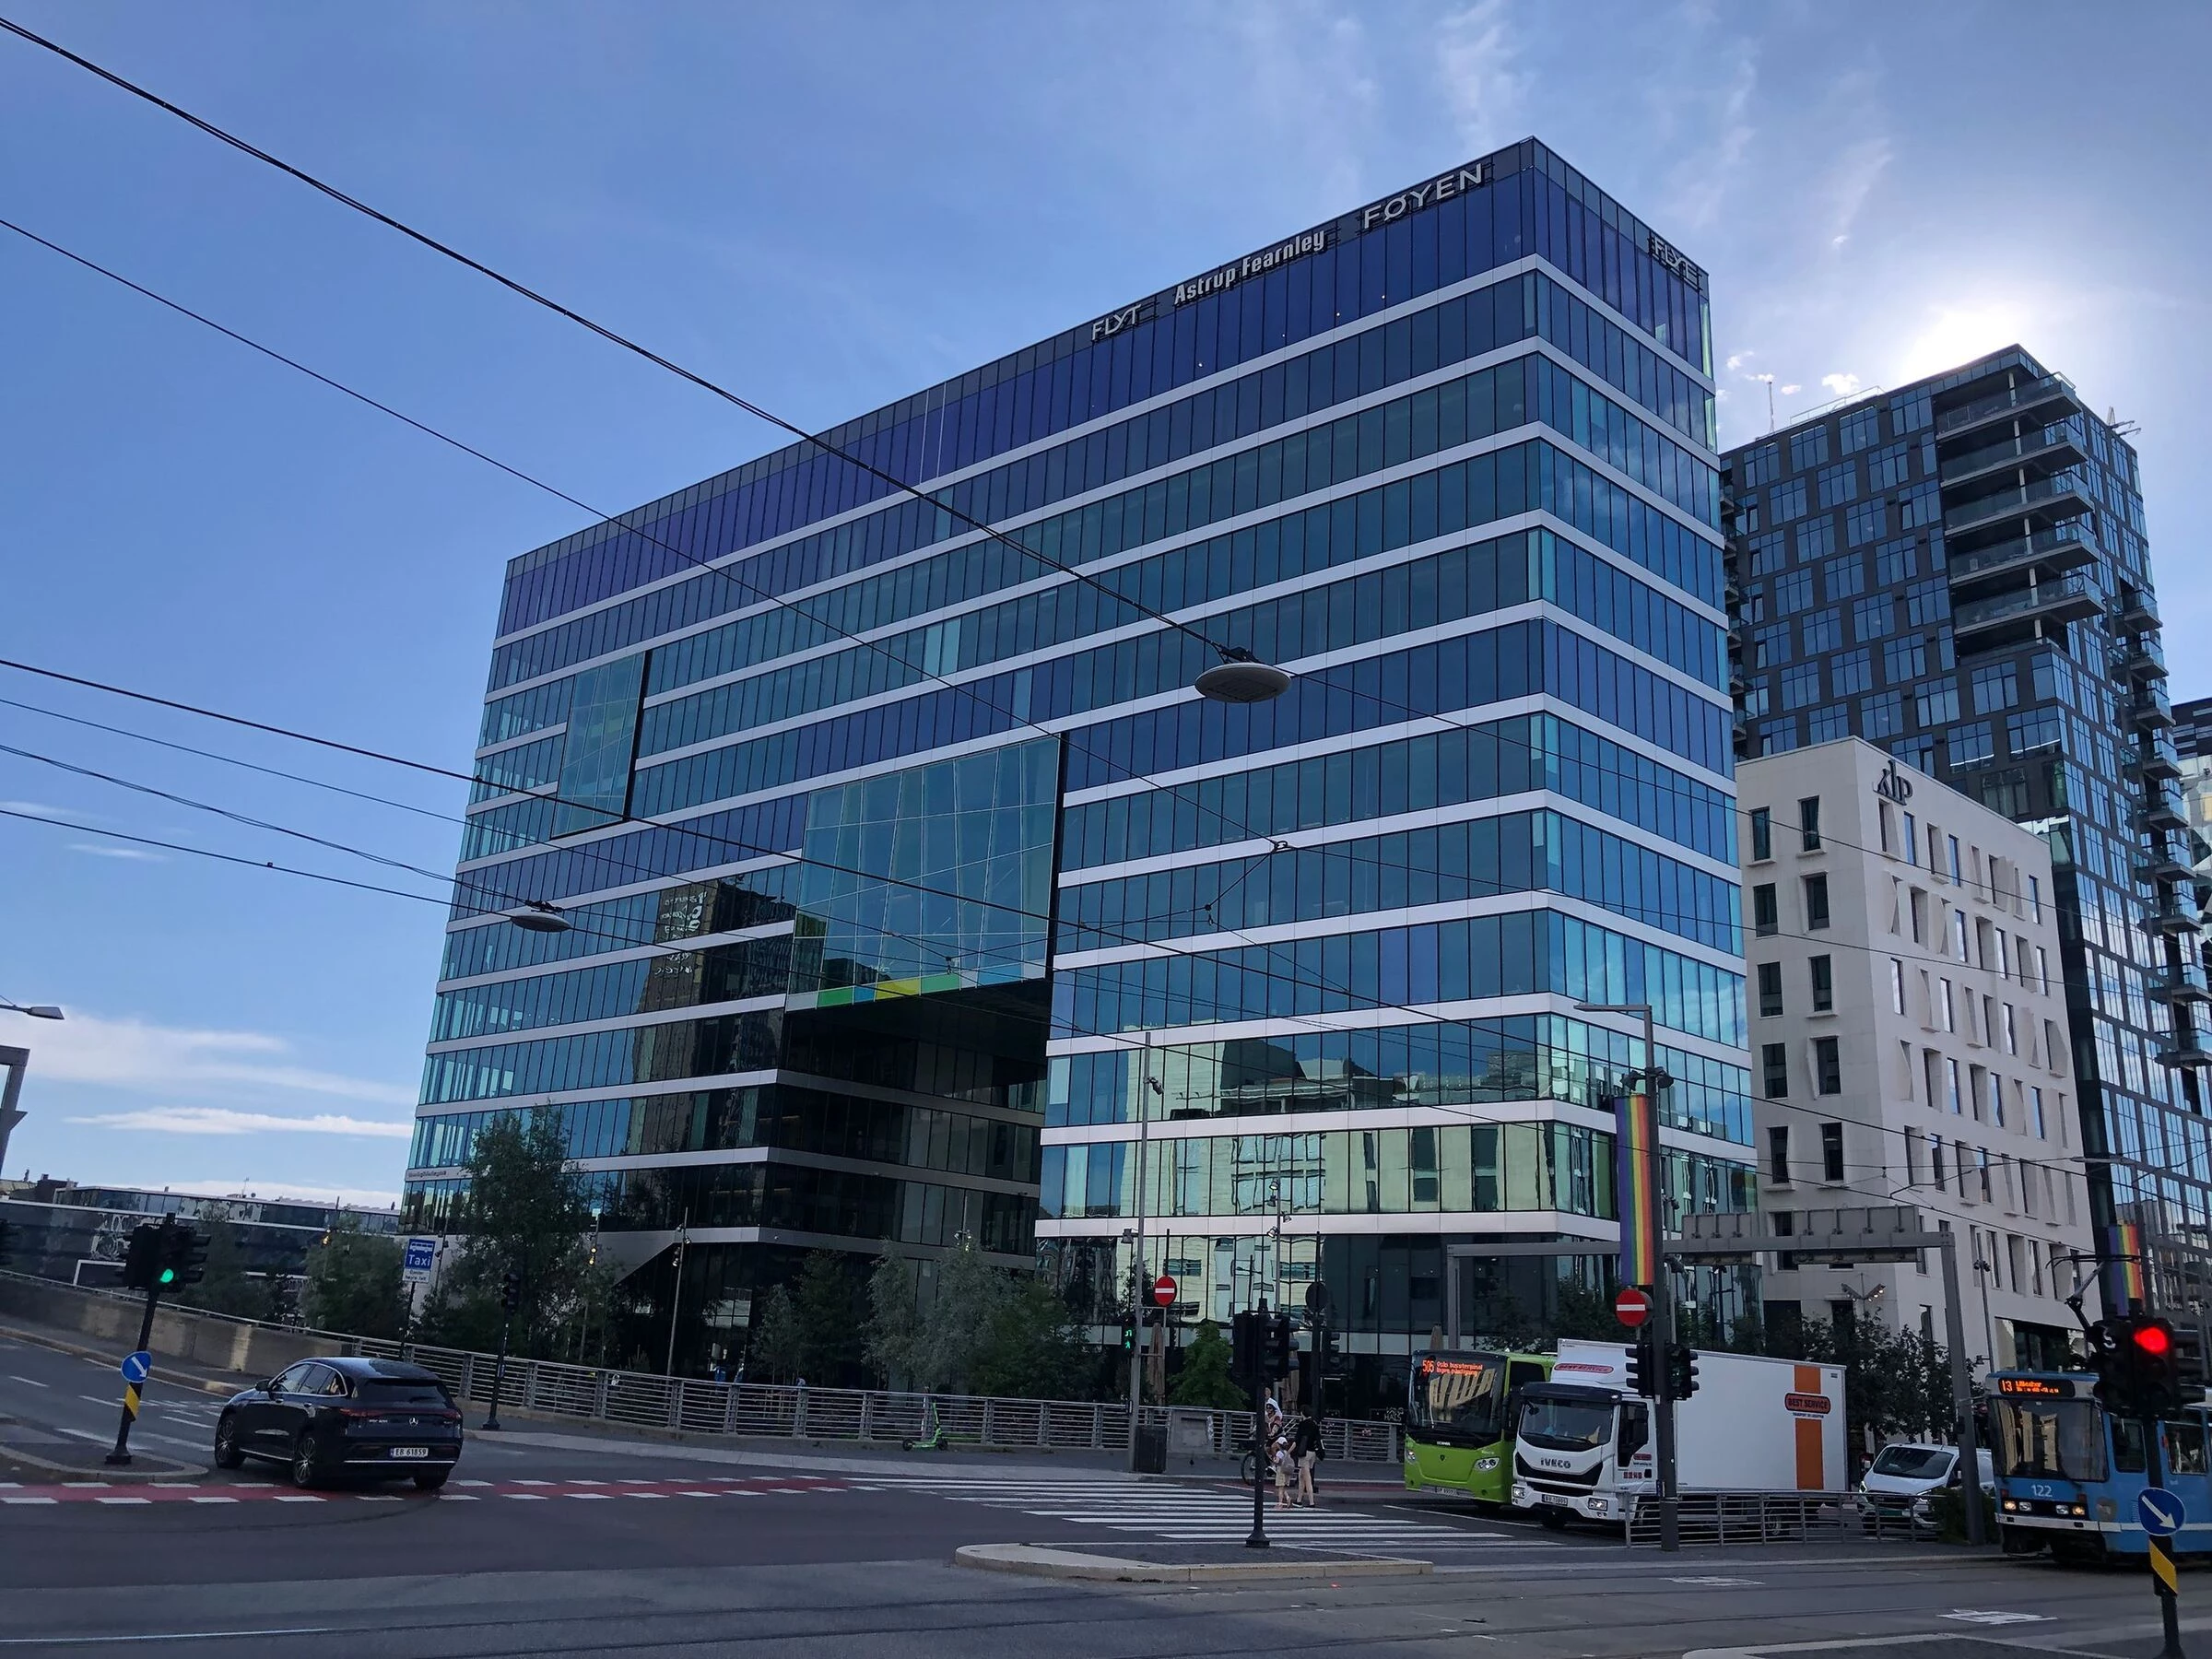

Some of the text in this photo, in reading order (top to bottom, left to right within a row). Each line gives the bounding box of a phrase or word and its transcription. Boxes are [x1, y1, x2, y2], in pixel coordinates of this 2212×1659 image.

[1364, 162, 1483, 229] FØYEN
[1174, 230, 1325, 305] Astrup Fearnley
[1091, 303, 1142, 341] FLYT
[408, 1253, 431, 1266] Taxi
[2002, 1380, 2013, 1393] 13
[1788, 1397, 1829, 1410] BEST SERVICE
[1540, 1457, 1571, 1469] IVECO
[2030, 1484, 2053, 1498] 122
